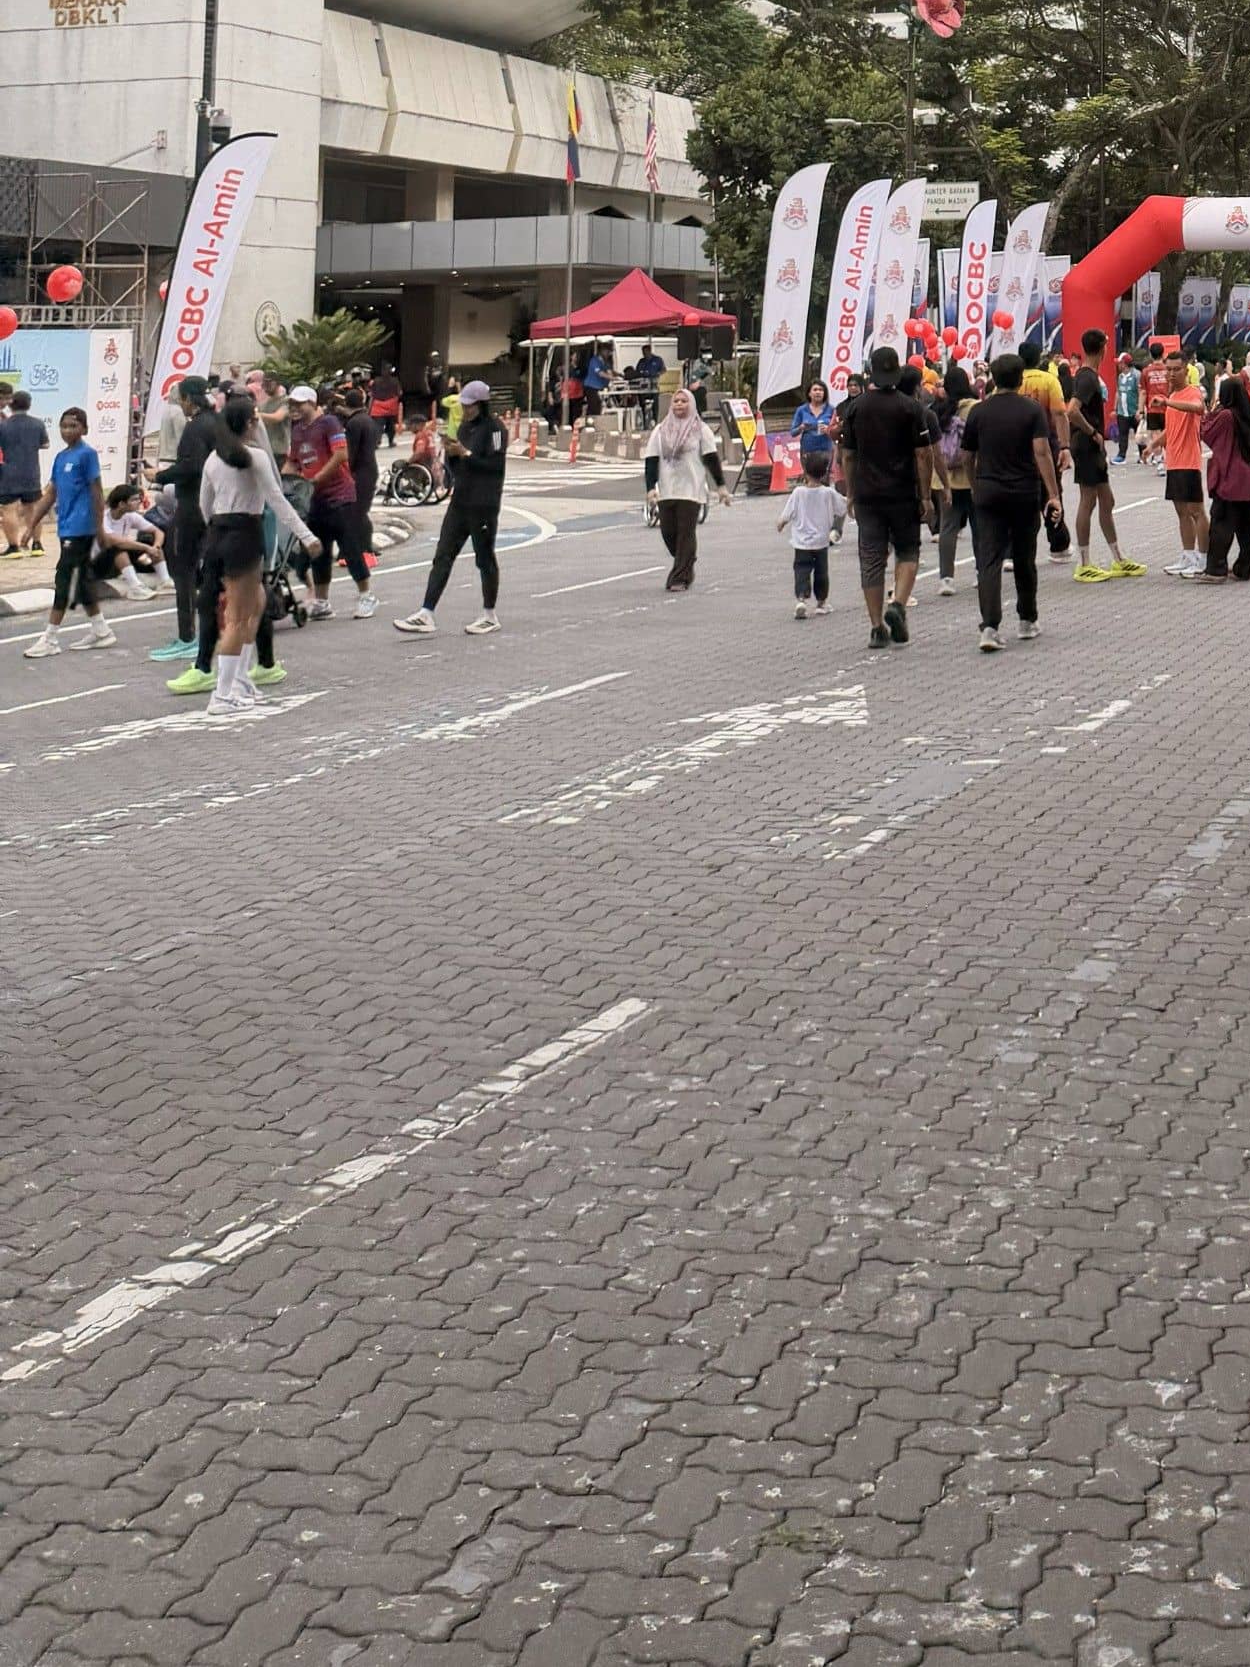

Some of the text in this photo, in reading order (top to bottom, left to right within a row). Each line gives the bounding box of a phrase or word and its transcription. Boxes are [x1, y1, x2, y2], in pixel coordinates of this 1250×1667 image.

[55, 7, 119, 26] DBKL 1
[172, 168, 245, 370] OCBC Al-Amin
[836, 205, 873, 363] OCBC Al-Amin
[966, 241, 987, 324] OCBC
